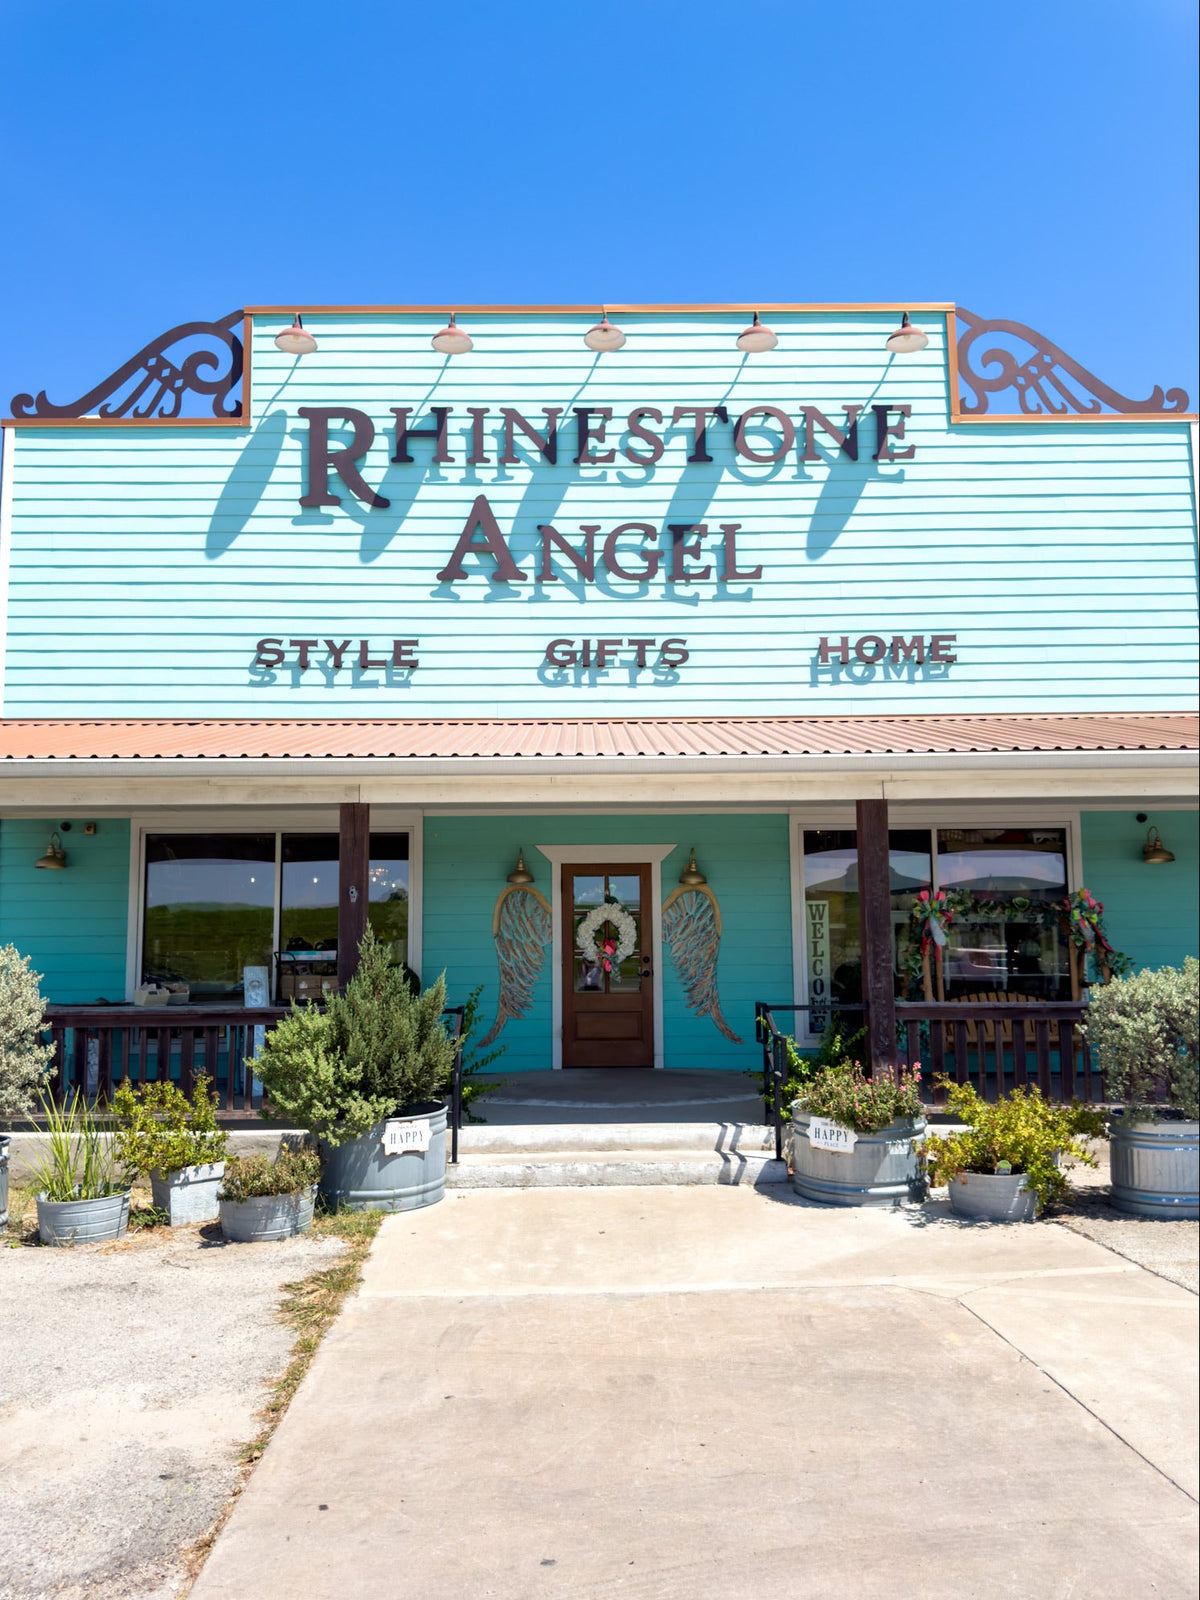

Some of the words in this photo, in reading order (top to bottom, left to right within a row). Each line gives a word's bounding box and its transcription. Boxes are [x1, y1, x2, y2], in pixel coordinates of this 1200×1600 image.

[298, 405, 915, 509] RHINESTONE
[437, 495, 763, 583] ANGEL
[256, 638, 419, 668] STYLE
[546, 638, 689, 668] GIFTS
[820, 635, 957, 665] HOME
[391, 1131, 423, 1145] HAPPY
[815, 1127, 848, 1142] HAPPY
